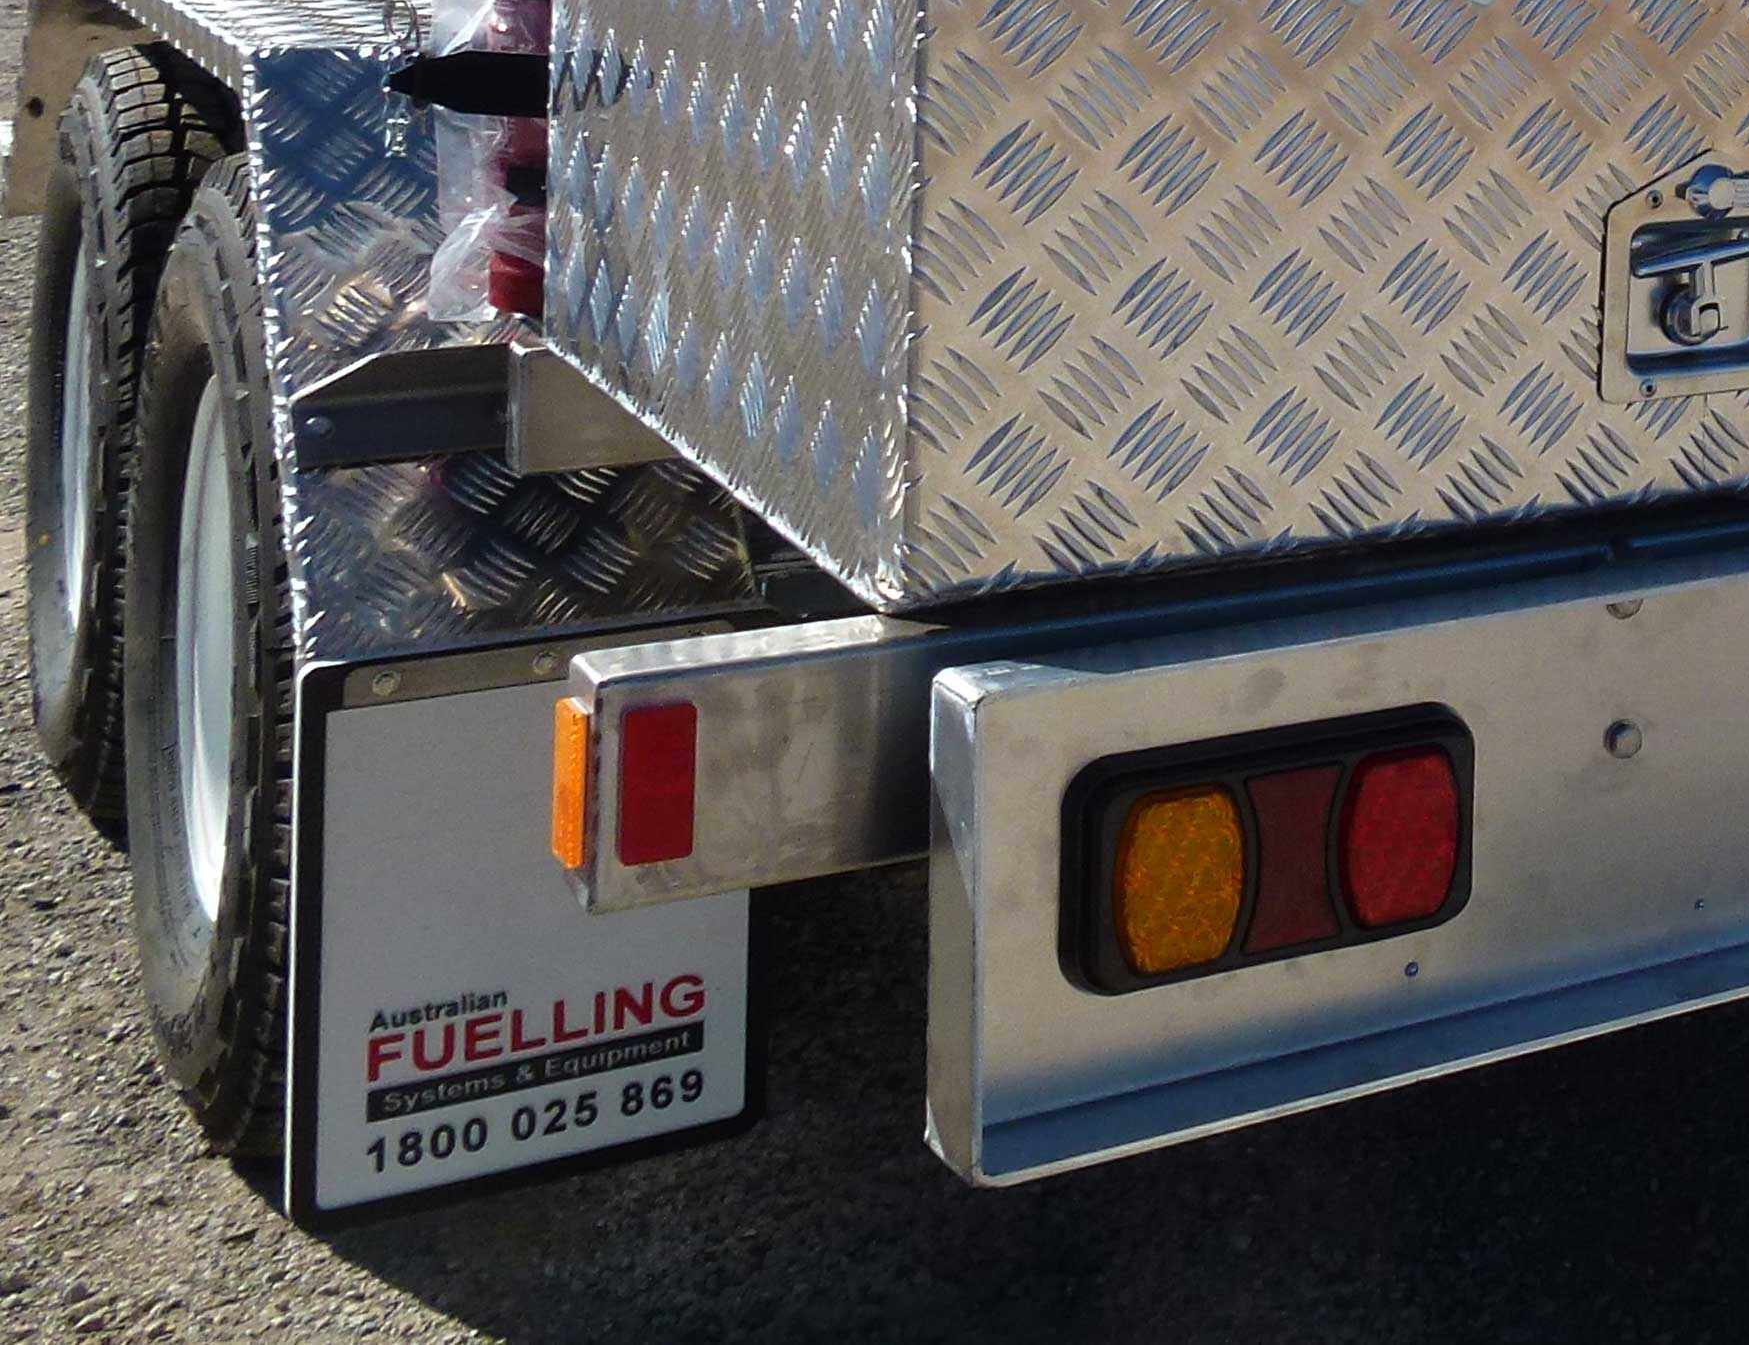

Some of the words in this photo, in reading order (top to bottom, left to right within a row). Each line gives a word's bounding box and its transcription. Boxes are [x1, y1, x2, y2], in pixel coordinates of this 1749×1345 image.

[365, 974, 706, 1084] FUELLING
[369, 988, 508, 1033] Australian
[382, 1075, 507, 1114] Systems
[515, 1064, 534, 1086] &
[544, 1030, 691, 1078] Equipment
[366, 1117, 489, 1173] 1800
[511, 1090, 599, 1141] 025
[619, 1069, 704, 1117] 869
